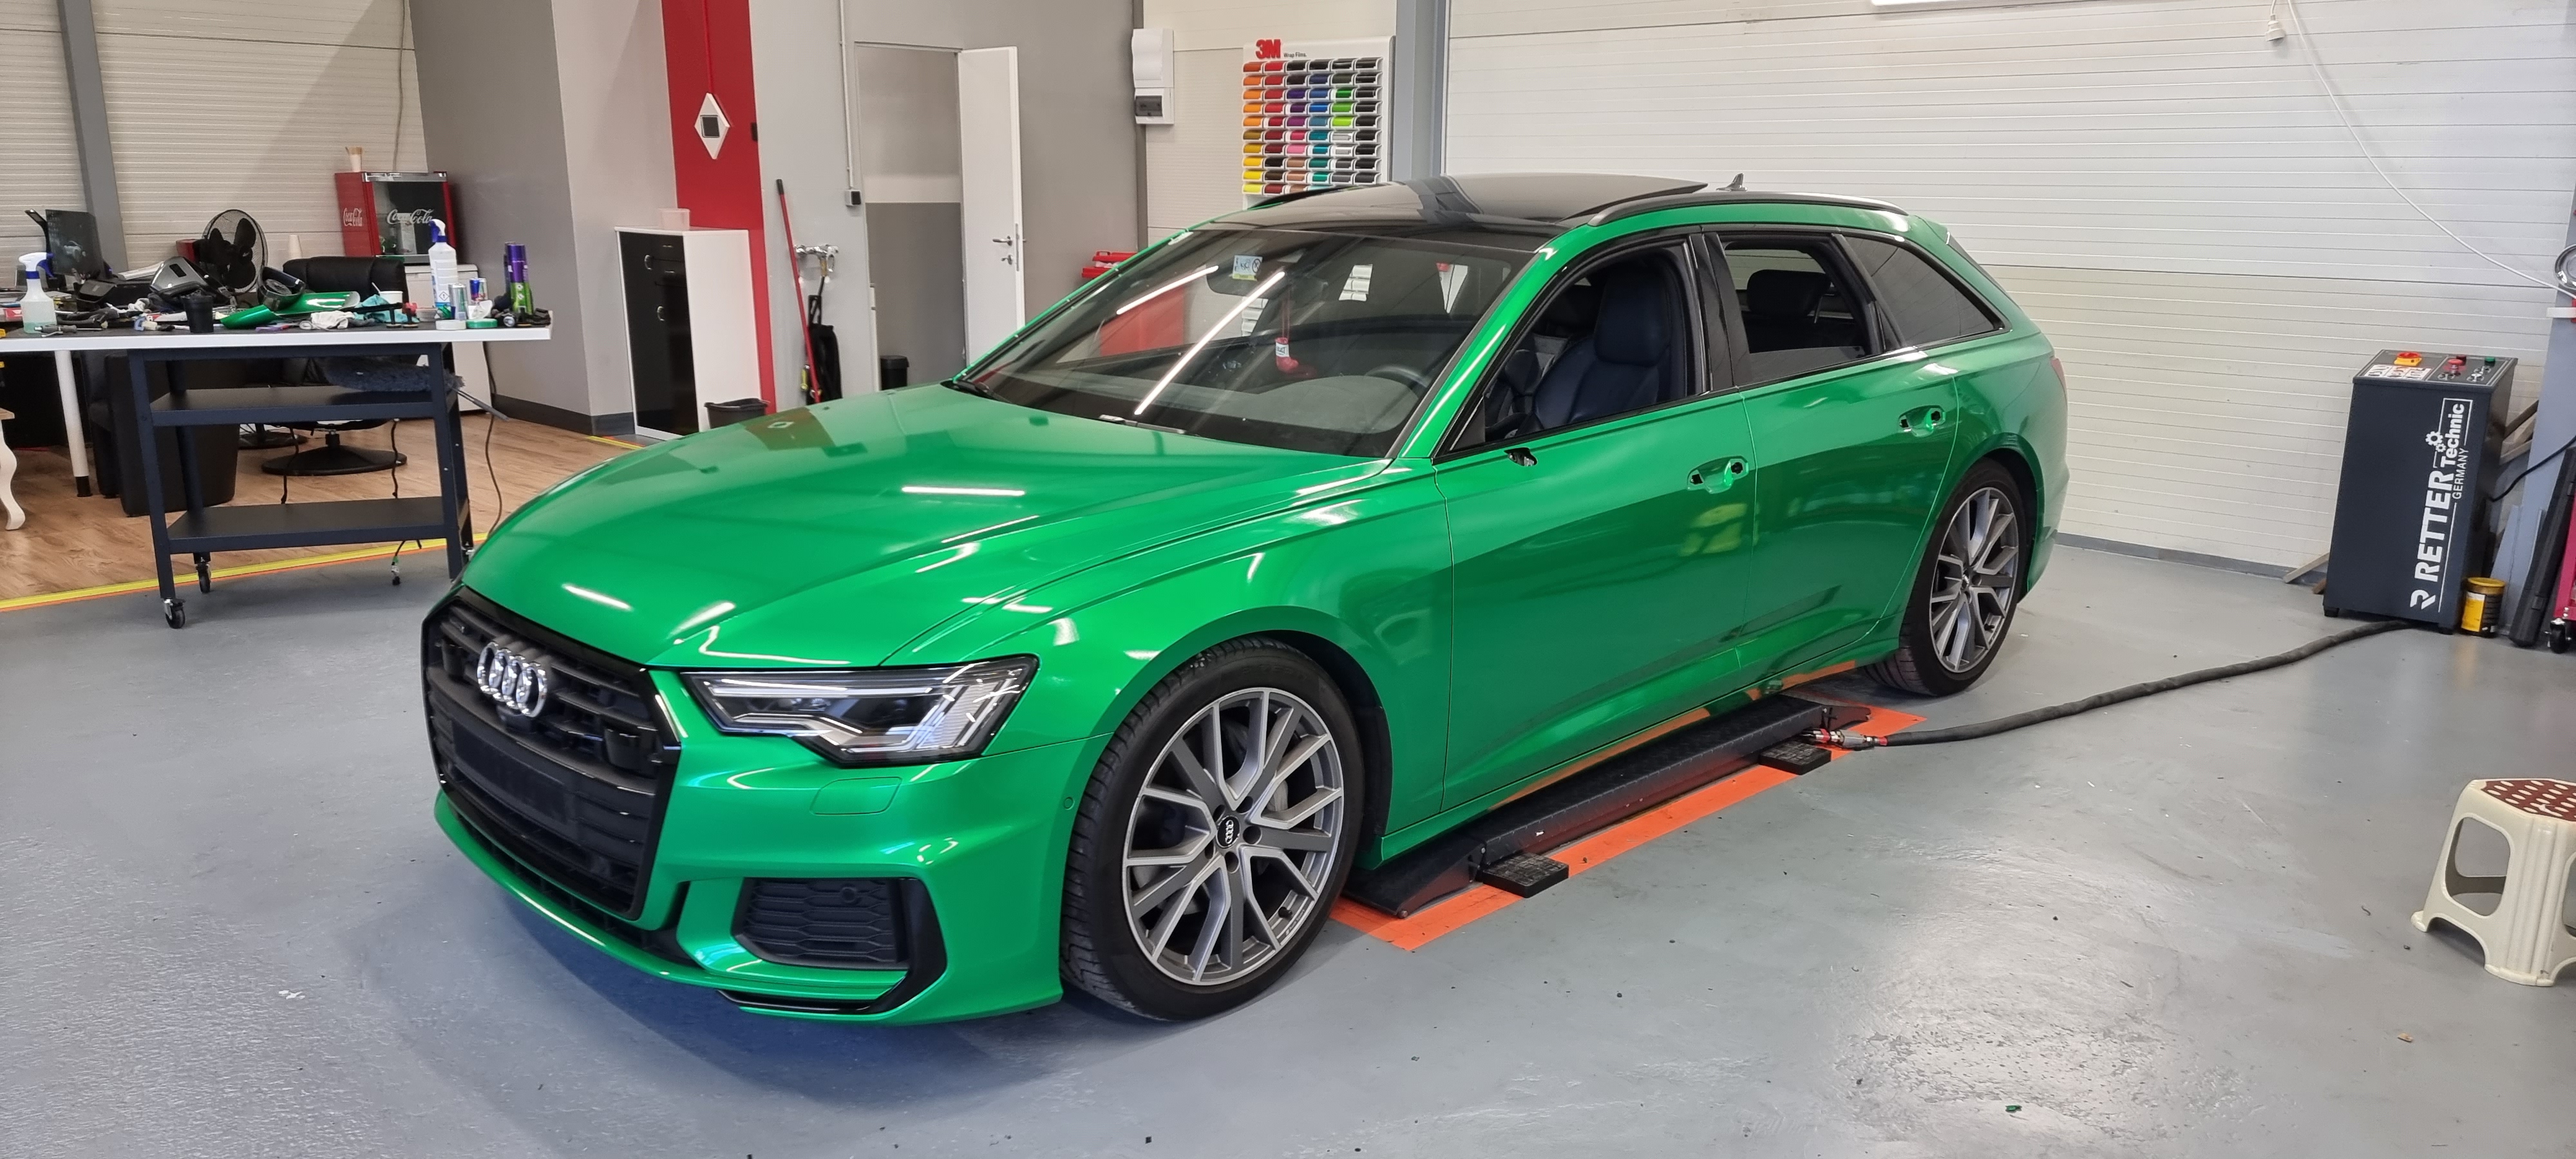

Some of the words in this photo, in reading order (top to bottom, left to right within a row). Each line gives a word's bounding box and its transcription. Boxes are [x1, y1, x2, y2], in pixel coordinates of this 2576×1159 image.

[1255, 39, 1281, 59] 3M
[2440, 403, 2465, 468] Technic
[2452, 448, 2469, 500] GERMANY
[2414, 471, 2454, 582] RETTER
